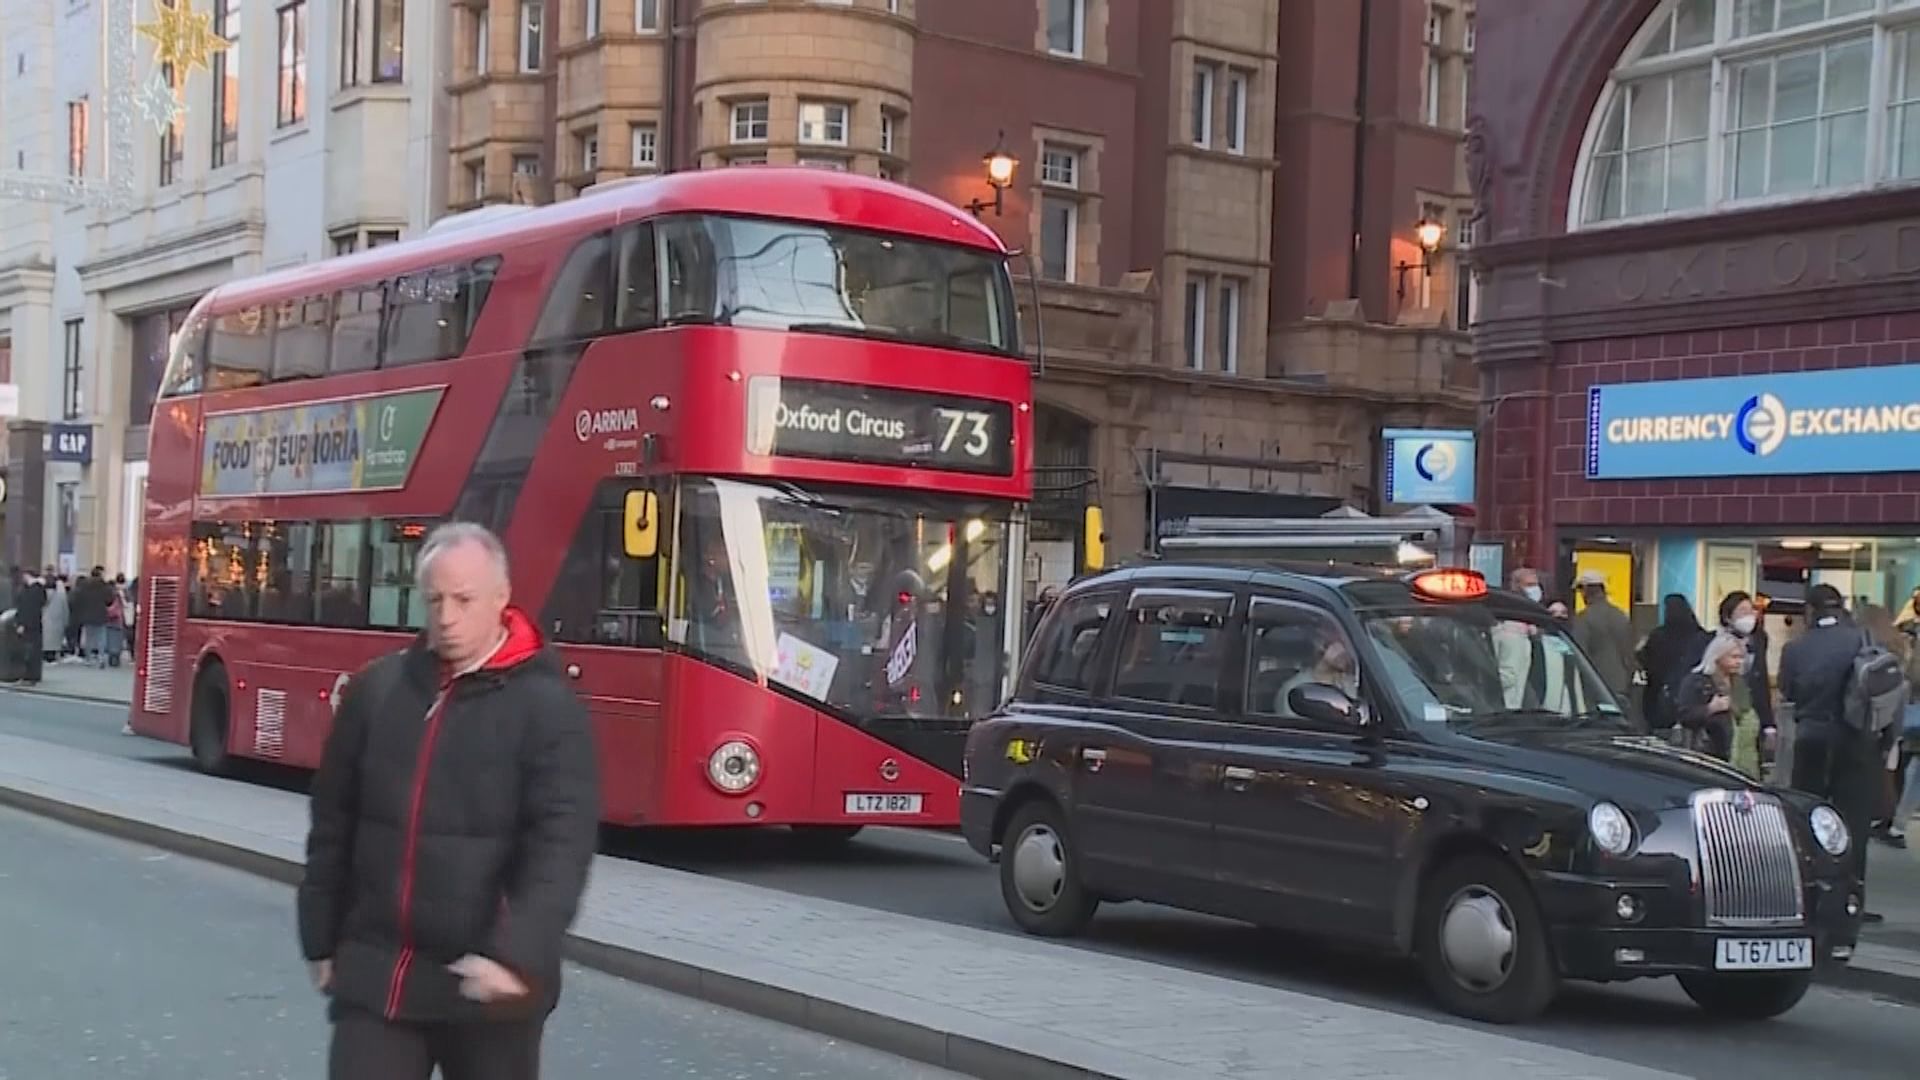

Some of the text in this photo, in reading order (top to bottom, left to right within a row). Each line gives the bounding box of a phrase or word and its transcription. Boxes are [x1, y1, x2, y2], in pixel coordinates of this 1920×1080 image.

[591, 408, 639, 433] ARRIVA
[774, 402, 991, 457] Oxford Circus 73
[1606, 412, 1735, 444] CURRENCY
[58, 433, 87, 453] GAP
[213, 439, 251, 470] FOOD
[1438, 577, 1481, 593] TAXI
[1725, 940, 1806, 963] LT67 LCY
